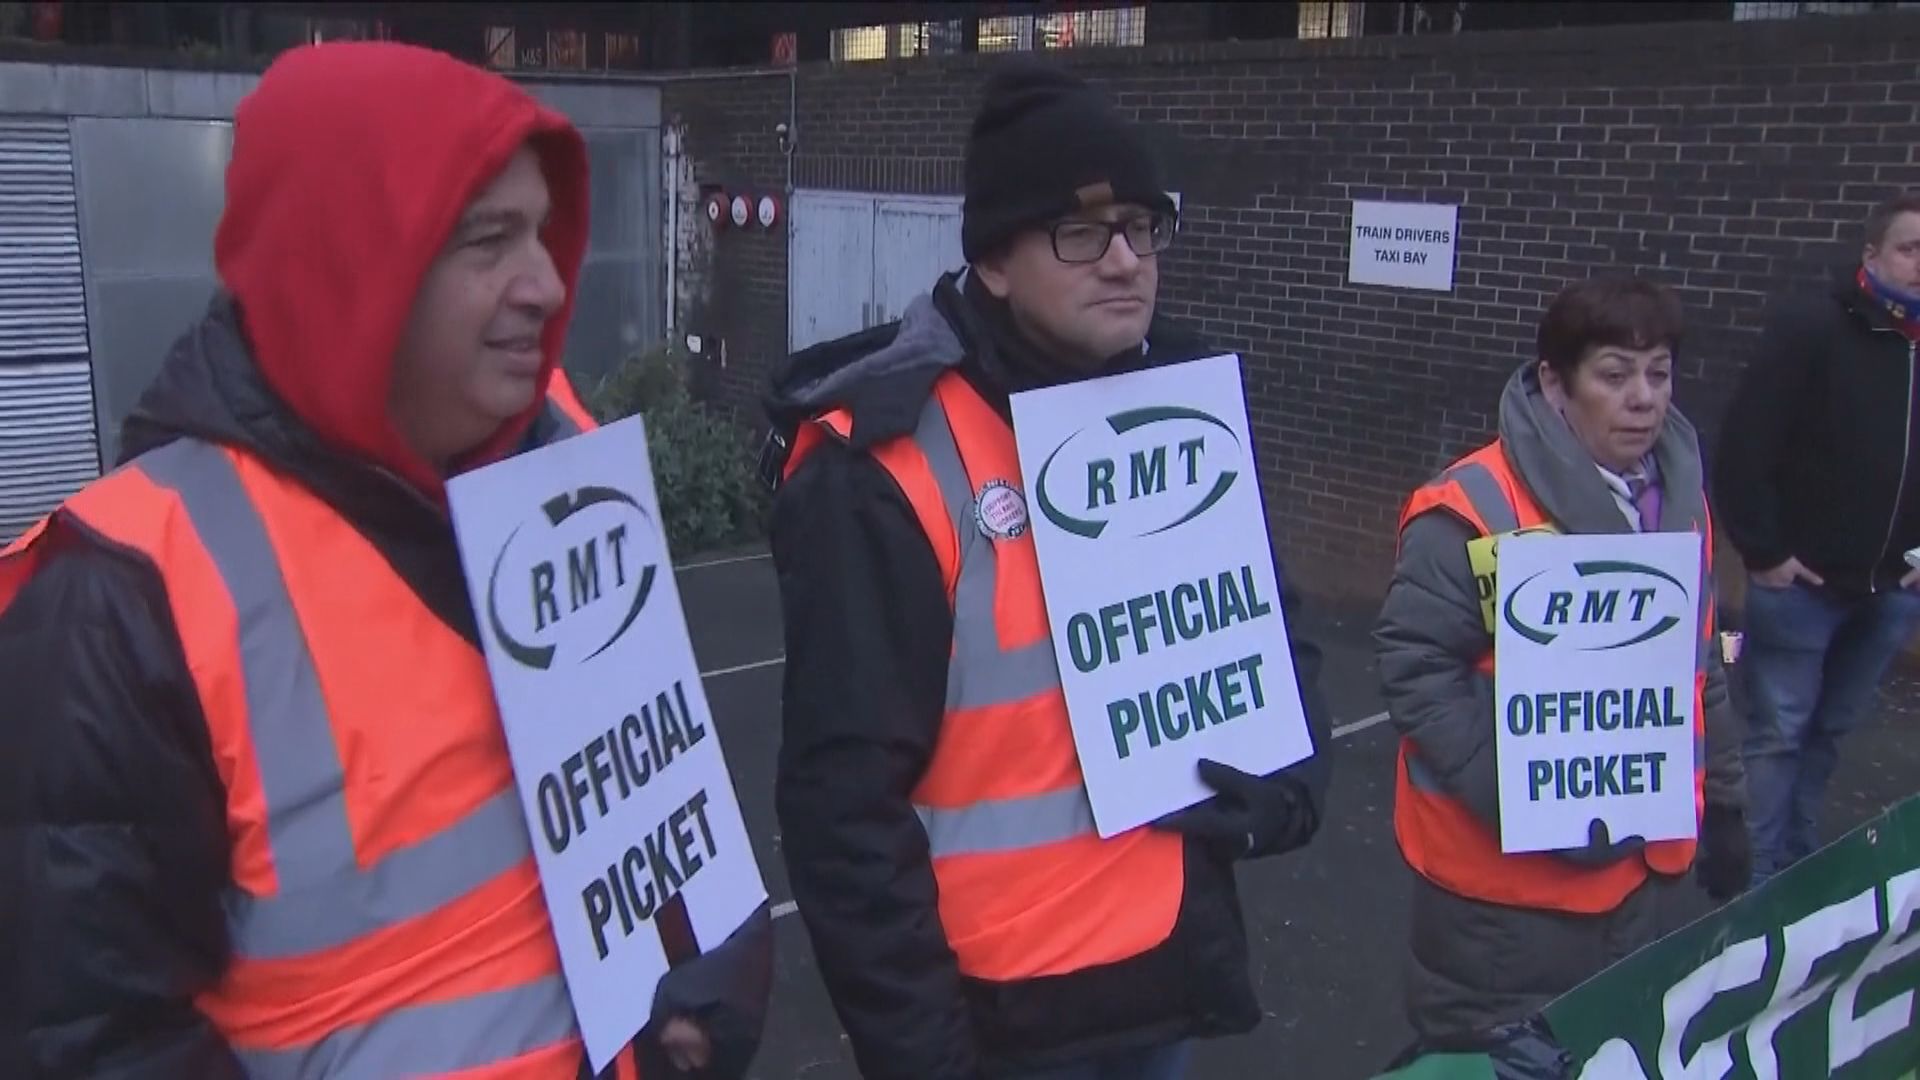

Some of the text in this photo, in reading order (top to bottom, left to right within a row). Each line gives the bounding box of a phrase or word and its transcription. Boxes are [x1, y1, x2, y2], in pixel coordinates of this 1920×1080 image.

[1356, 225, 1450, 243] TRAIN DRIVERS
[1374, 249, 1428, 265] TAXI BAY
[1086, 436, 1205, 511] RMT
[531, 524, 626, 632] RMT
[1543, 588, 1656, 625] RMT
[1067, 565, 1271, 672] OFFICIAL
[1106, 654, 1264, 759] PICKET
[1507, 686, 1684, 736] OFFICIAL
[538, 681, 705, 854] OFFICIAL
[1528, 752, 1666, 801] PICKET
[582, 788, 716, 962] PICKET
